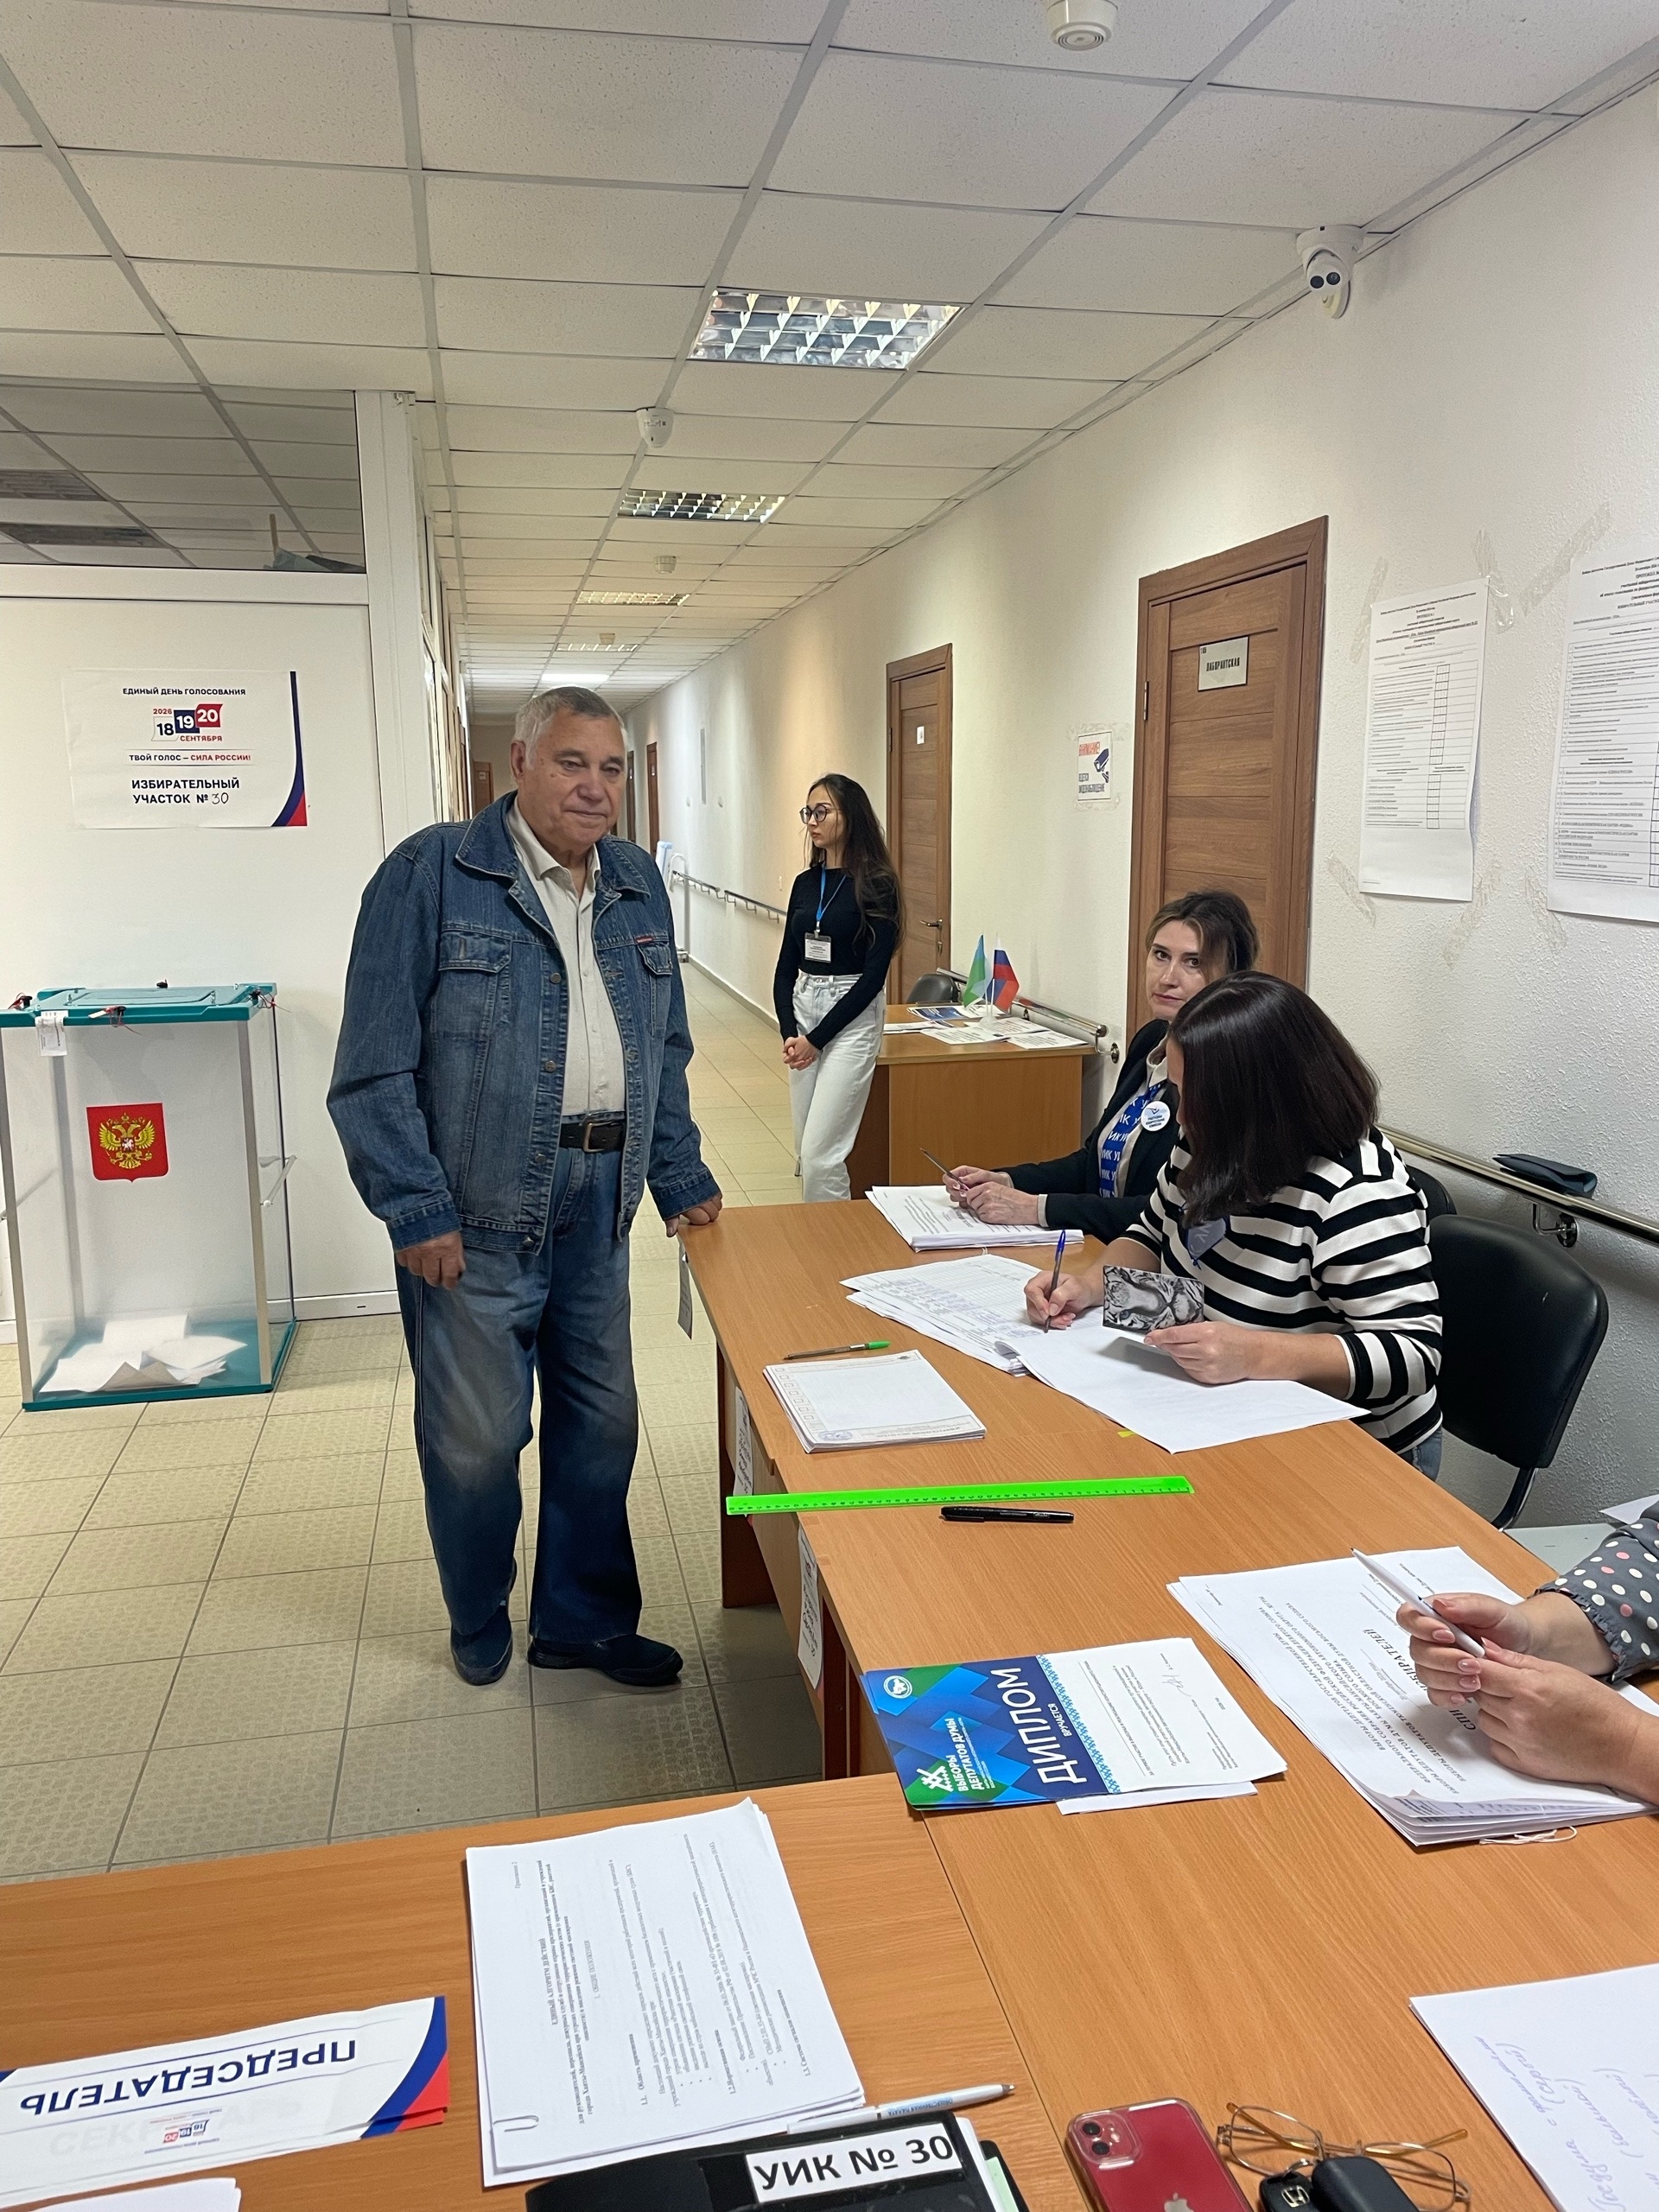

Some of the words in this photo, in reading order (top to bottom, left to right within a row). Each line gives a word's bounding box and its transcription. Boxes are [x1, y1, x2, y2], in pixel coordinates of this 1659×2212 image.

[1206, 658, 1240, 671] ЛАБОРАНТСКАЯ
[123, 687, 159, 696] ЕДИНЫЙ
[156, 723, 174, 735] 18
[176, 715, 194, 729] 19
[197, 709, 219, 722] 20
[131, 777, 239, 789] ИЗБИРАТЕЛЬНЫЙ
[133, 794, 191, 804] УЧАСТОК
[196, 794, 208, 804] №
[211, 792, 230, 805] 30
[944, 1717, 966, 1742] ДУМЫ
[989, 1667, 1089, 1785] ДИПЛОМ
[1046, 1703, 1072, 1738] ВРУЧАЕТСЯ
[945, 1753, 969, 1792] ВЫБОРЫ
[957, 1739, 986, 1791] ДЕПУТАТОВ
[537, 1937, 549, 1967] ДЕЙСТВИЙ
[543, 1967, 554, 1999] АЛГОРИТМ
[21, 2040, 356, 2116] ПРЕДСЕДАТЕЛЬ
[754, 2155, 842, 2190] УИК
[849, 2147, 899, 2176] №
[906, 2135, 954, 2164] 30
